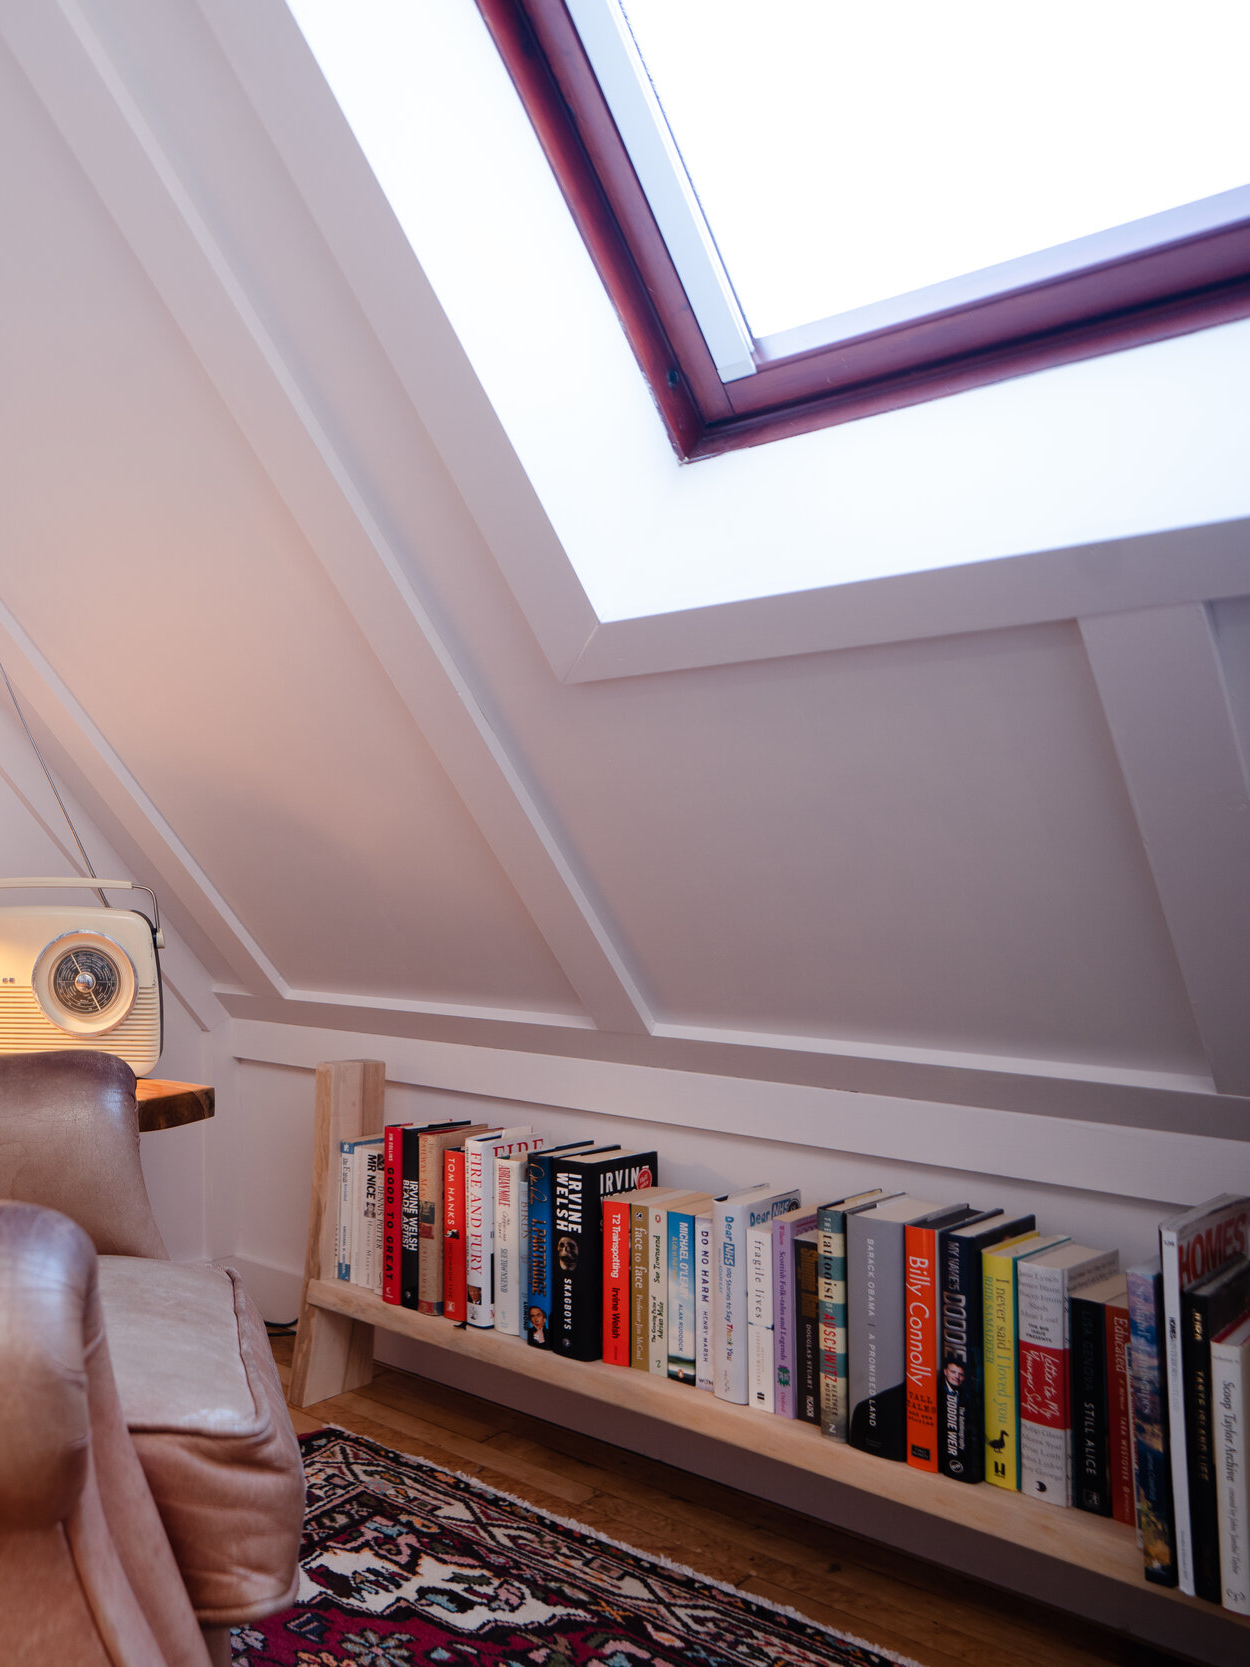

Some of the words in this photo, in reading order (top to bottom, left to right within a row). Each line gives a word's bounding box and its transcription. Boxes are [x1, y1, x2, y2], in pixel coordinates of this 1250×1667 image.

[367, 1154, 377, 1172] MR
[447, 1158, 456, 1181] TOM
[470, 1152, 482, 1188] FIRE
[498, 1164, 510, 1188] ADRIAN
[367, 1174, 376, 1200] NICE
[386, 1167, 394, 1204] GOOD
[599, 1165, 650, 1195] IRVIN
[376, 1185, 384, 1216] DENNIS
[402, 1180, 410, 1214] BLADE
[409, 1181, 419, 1215] IRVINE
[447, 1187, 455, 1225] HANKS
[470, 1193, 482, 1228] AND
[498, 1188, 510, 1208] MOLE
[556, 1172, 569, 1232] WELSH
[568, 1173, 582, 1234] IRVINE
[386, 1212, 394, 1229] TO
[402, 1216, 411, 1248] ARTIST
[408, 1216, 419, 1252] WELSH
[612, 1213, 621, 1225] T2
[725, 1216, 734, 1242] Dear
[750, 1210, 770, 1227] Dear
[823, 1217, 831, 1233] THE
[471, 1233, 482, 1275] FURY
[500, 1248, 508, 1259] SUE
[610, 1225, 621, 1278] Trainspotting
[635, 1227, 647, 1250] face
[653, 1235, 661, 1269] Townsend
[678, 1221, 689, 1261] MICHAEL
[701, 1230, 709, 1246] DO
[724, 1242, 735, 1266] NHS
[948, 1240, 960, 1256] MY
[1178, 1212, 1247, 1291] HOMES
[385, 1236, 394, 1280] GREAT
[531, 1226, 547, 1297] PARTRIDGE
[635, 1252, 642, 1262] to
[701, 1250, 709, 1265] NO
[752, 1240, 764, 1283] fragile
[779, 1251, 787, 1279] Scottish
[823, 1234, 837, 1299] tattooist
[866, 1238, 875, 1278] BARACK
[500, 1259, 508, 1293] TOWNSEND
[635, 1266, 647, 1288] face
[678, 1263, 689, 1299] O'LEARY
[701, 1270, 709, 1303] HARM
[906, 1256, 931, 1297] Billy
[984, 1275, 994, 1301] RHIK
[563, 1278, 572, 1331] SKAGBOYS
[611, 1287, 620, 1312] Irvine
[636, 1294, 644, 1322] Professor
[725, 1302, 731, 1310] to
[755, 1289, 765, 1319] lives
[779, 1281, 787, 1312] Folk-tales
[825, 1303, 833, 1313] OF
[867, 1281, 875, 1317] OBAMA
[997, 1288, 1007, 1323] never
[611, 1312, 620, 1339] Welsh
[724, 1311, 732, 1323] Say
[779, 1314, 787, 1330] and
[943, 1290, 967, 1363] DODDIE
[1081, 1309, 1095, 1336] LISA
[1192, 1309, 1203, 1341] JURA
[778, 1331, 787, 1361] Legends
[823, 1313, 837, 1383] AUSCHWITZ
[906, 1301, 932, 1387] Connolly
[985, 1303, 994, 1364] SAMADDER
[997, 1325, 1010, 1351] said
[1114, 1316, 1129, 1373] Educated
[726, 1347, 734, 1361] You
[868, 1344, 876, 1396] PROMISED
[997, 1353, 1010, 1361] I
[1039, 1351, 1060, 1386] Letter
[1081, 1341, 1095, 1391] GENOVA
[997, 1361, 1011, 1400] loved
[1194, 1370, 1206, 1406] TASTE
[1219, 1381, 1235, 1409] Scoop
[868, 1399, 877, 1428] LAND
[907, 1400, 936, 1414] TALES
[908, 1391, 933, 1404] TALL
[947, 1394, 958, 1431] DODDIE
[958, 1406, 966, 1415] The
[993, 1398, 1007, 1424] you
[1021, 1388, 1042, 1414] Self
[1083, 1401, 1096, 1433] STILL
[1118, 1416, 1127, 1436] TARA
[1196, 1408, 1208, 1452] ISLAND
[1220, 1413, 1237, 1445] Taylor
[948, 1431, 958, 1457] WEIR
[958, 1416, 966, 1451] Autobiography
[1084, 1438, 1097, 1478] ALICE
[1120, 1438, 1130, 1481] WESTOVER
[1225, 1446, 1239, 1482] Archive
